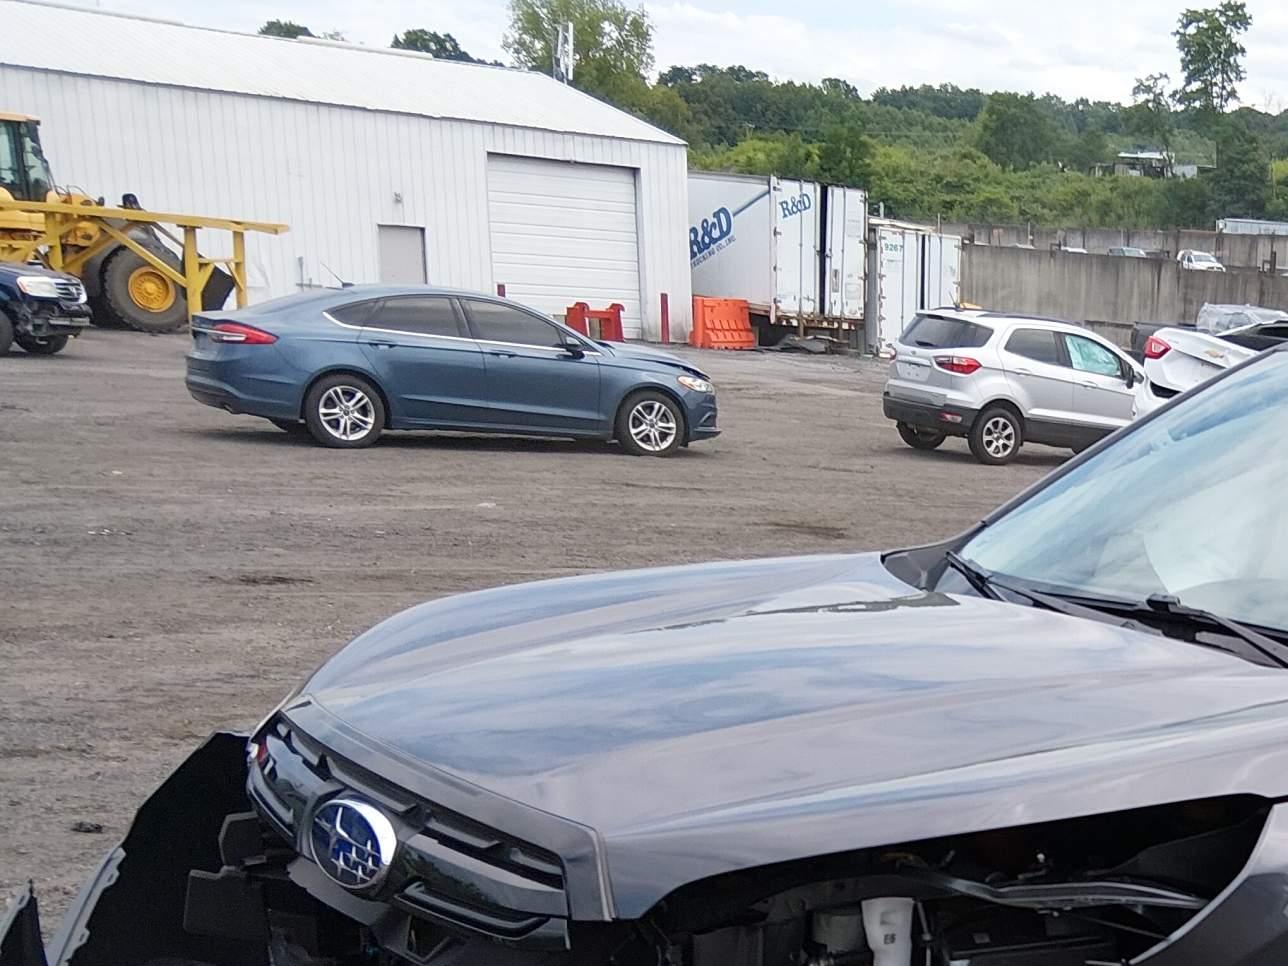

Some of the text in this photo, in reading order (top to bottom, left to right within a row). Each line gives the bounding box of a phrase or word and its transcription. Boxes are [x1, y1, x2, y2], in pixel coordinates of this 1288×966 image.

[779, 193, 811, 218] R&D
[689, 207, 732, 260] R&D
[884, 243, 903, 252] 9267
